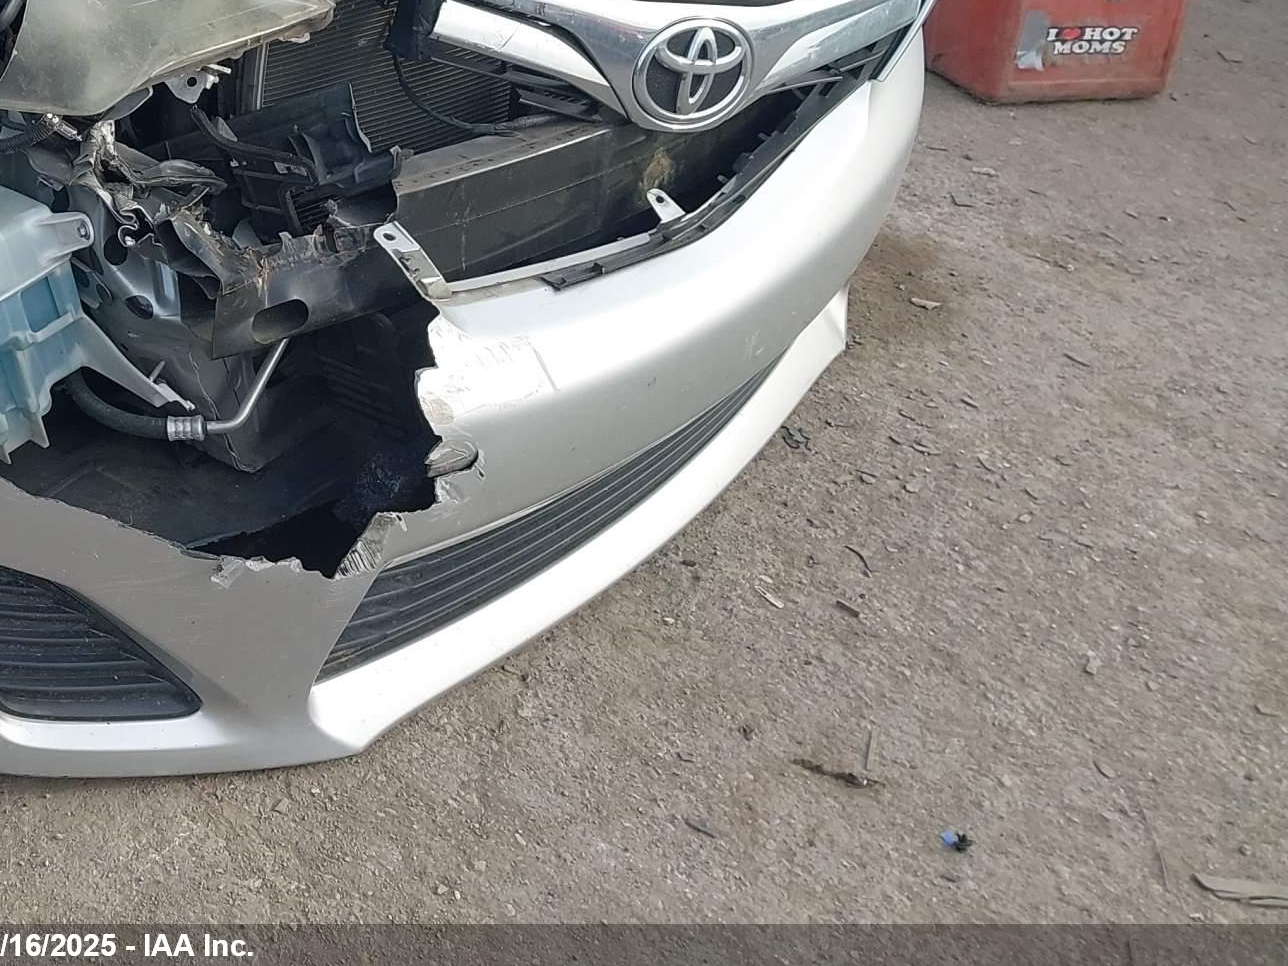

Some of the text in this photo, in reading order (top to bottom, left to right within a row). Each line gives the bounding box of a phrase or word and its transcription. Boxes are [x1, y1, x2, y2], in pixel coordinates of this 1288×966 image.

[1046, 27, 1138, 41] I HOT
[1053, 40, 1126, 55] MOMS
